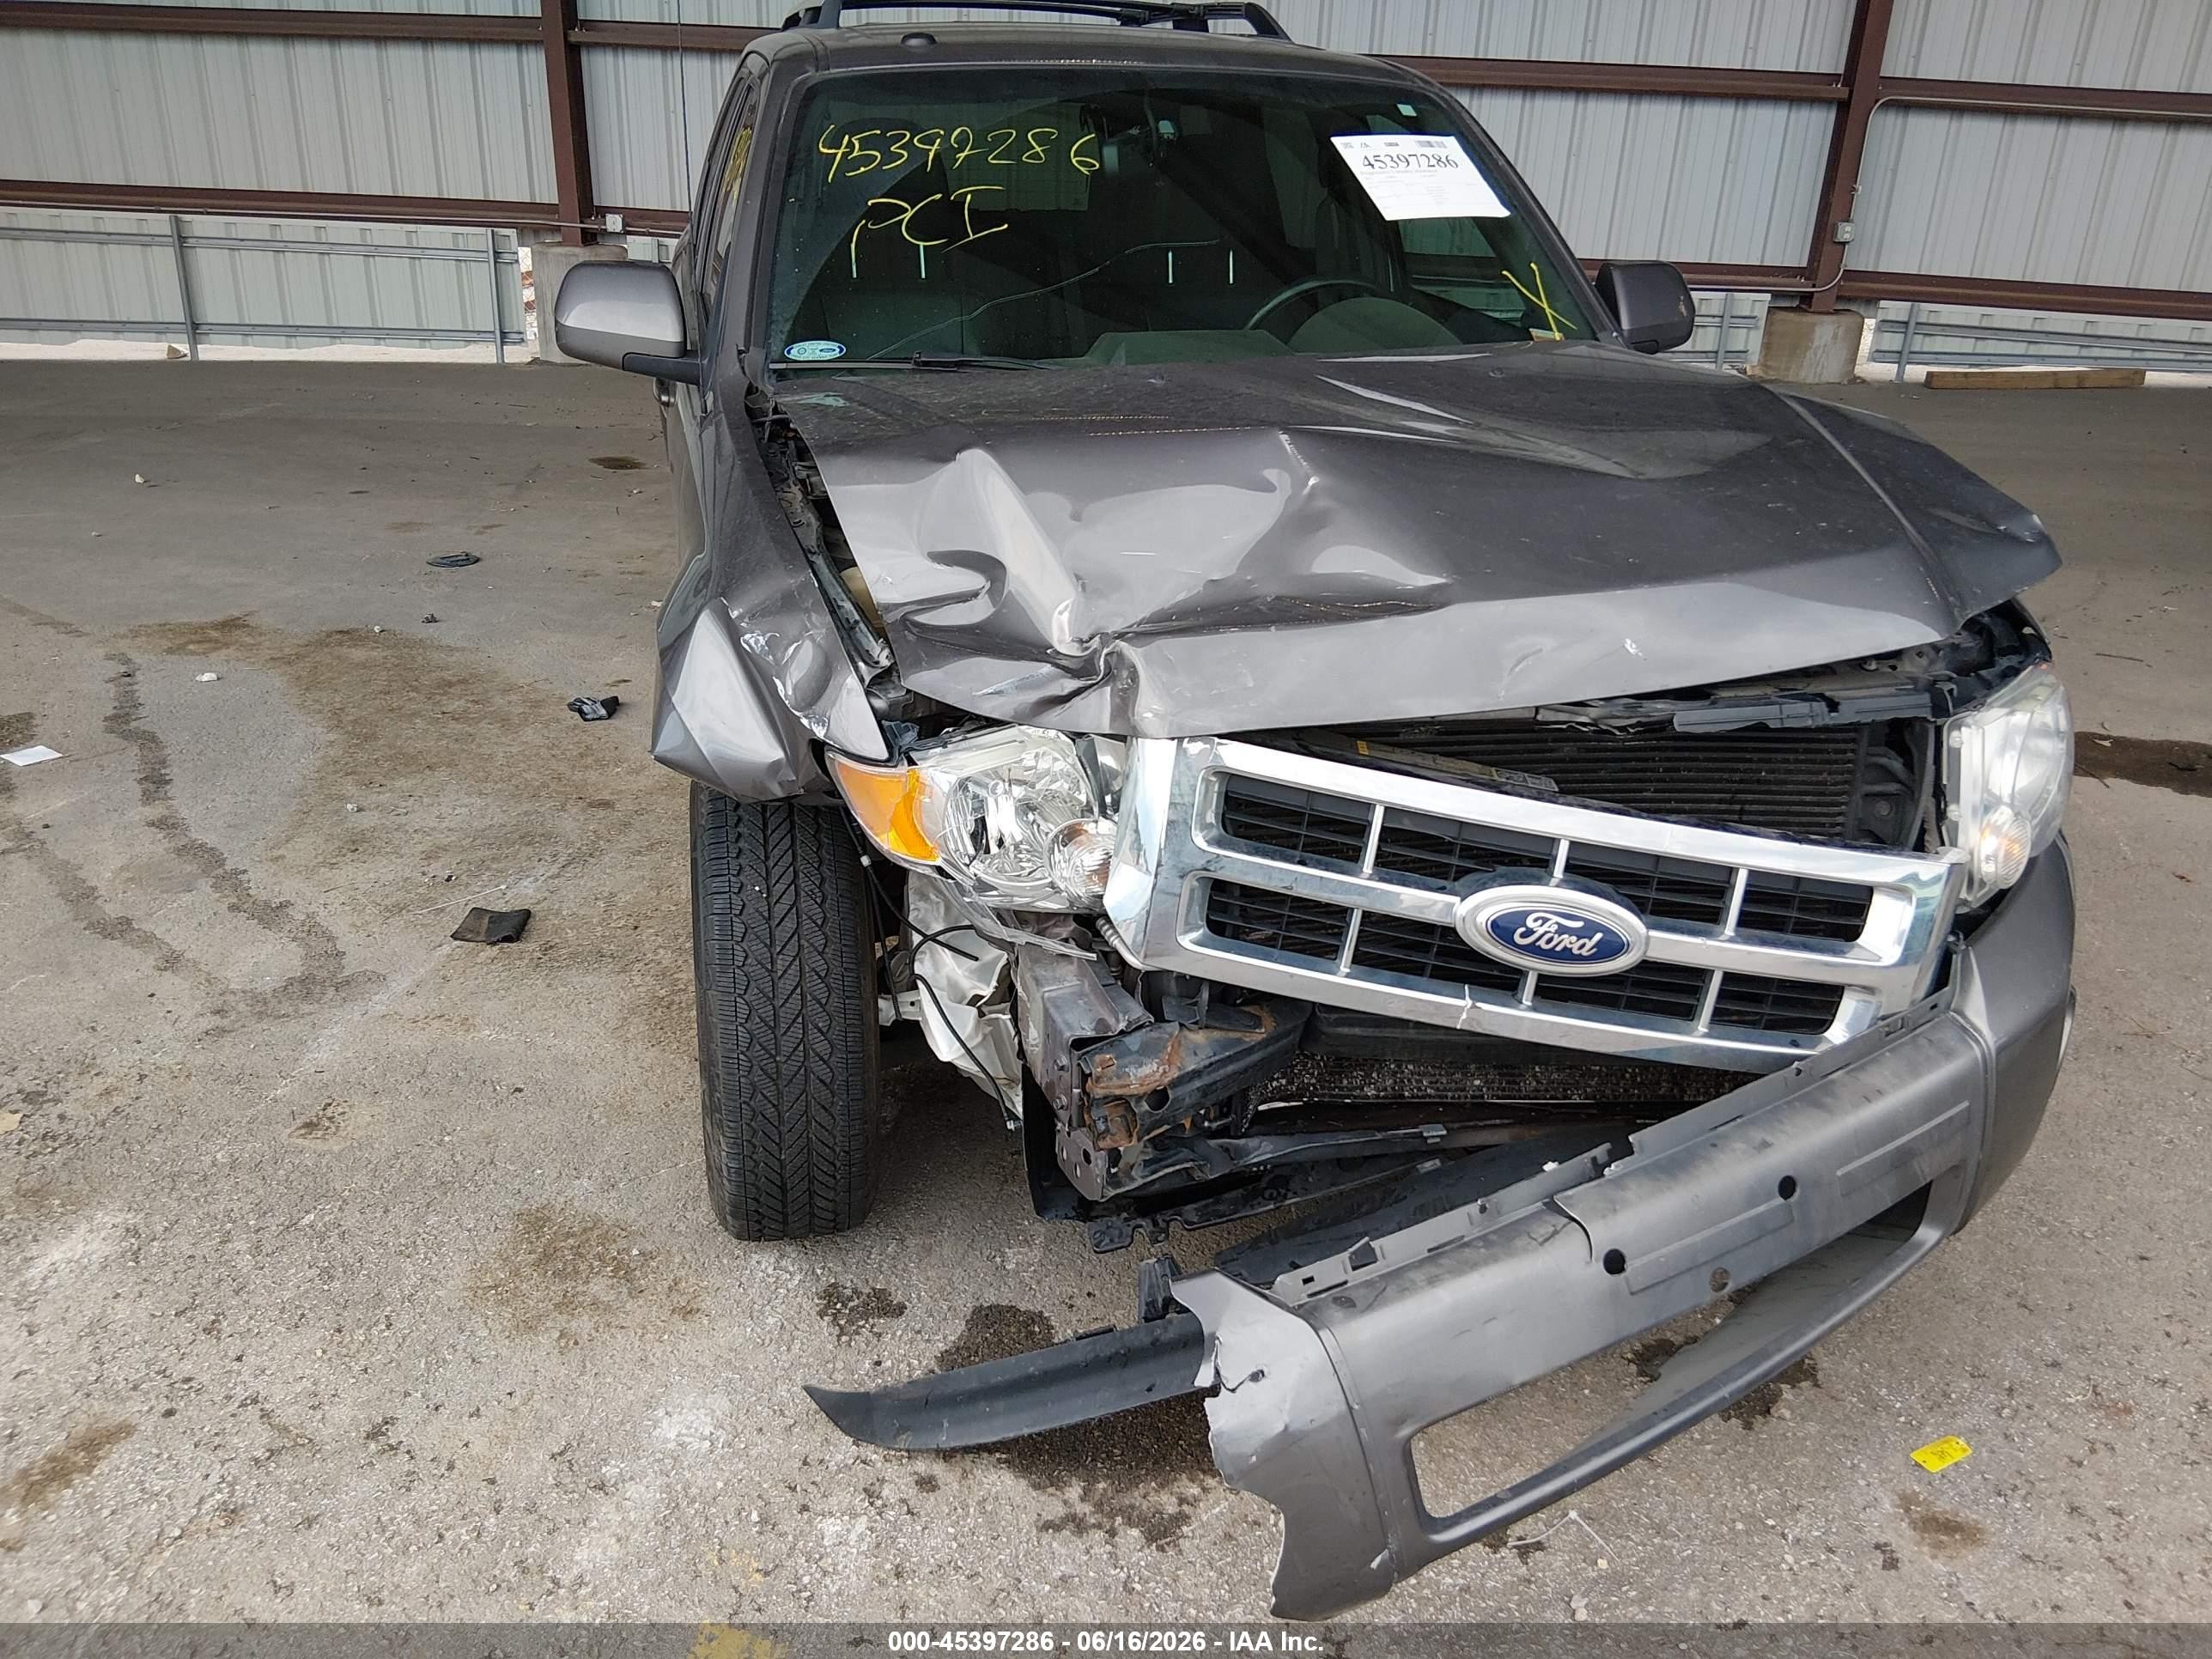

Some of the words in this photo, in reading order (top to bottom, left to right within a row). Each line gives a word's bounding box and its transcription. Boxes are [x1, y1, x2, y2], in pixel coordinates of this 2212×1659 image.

[818, 125, 1100, 183] 45397286
[1363, 154, 1458, 169] 45397286
[1514, 912, 1604, 956] Ford
